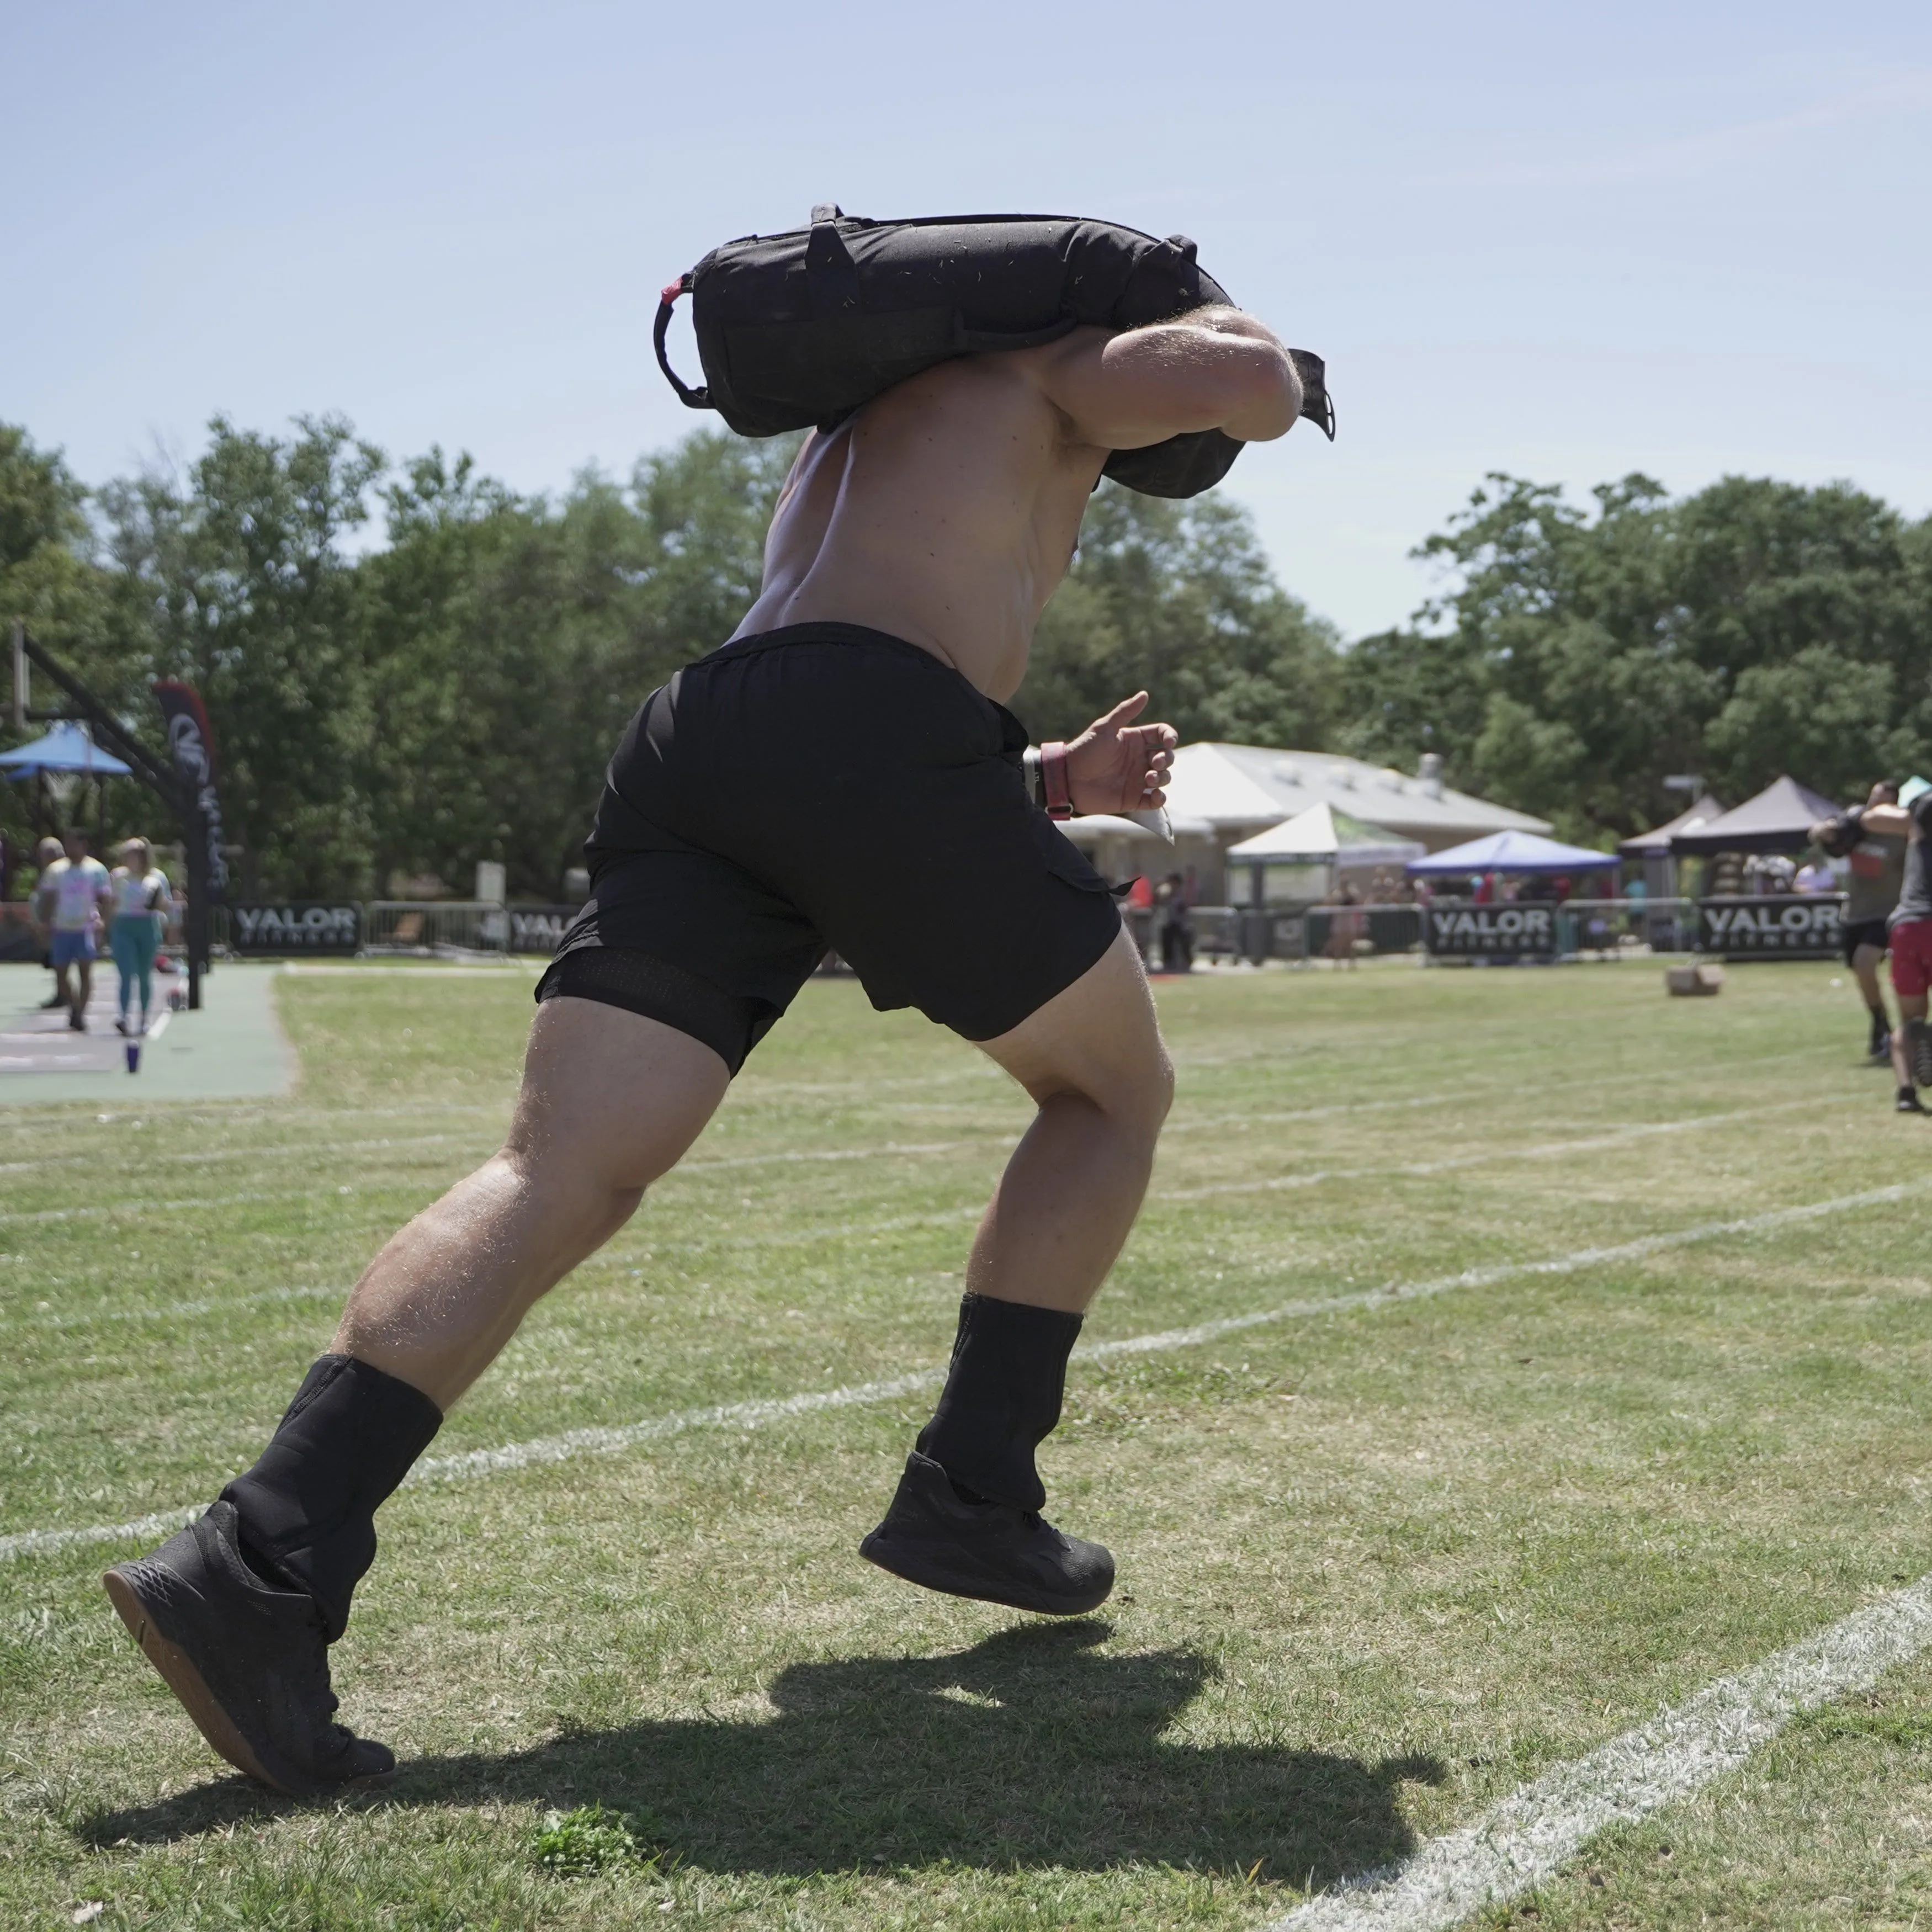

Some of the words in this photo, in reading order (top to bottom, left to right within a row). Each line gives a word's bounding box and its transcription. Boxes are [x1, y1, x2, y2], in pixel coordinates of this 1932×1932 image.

[236, 907, 357, 930] VALOR
[1431, 909, 1550, 933] VALOR
[1703, 905, 1841, 932] VALOR
